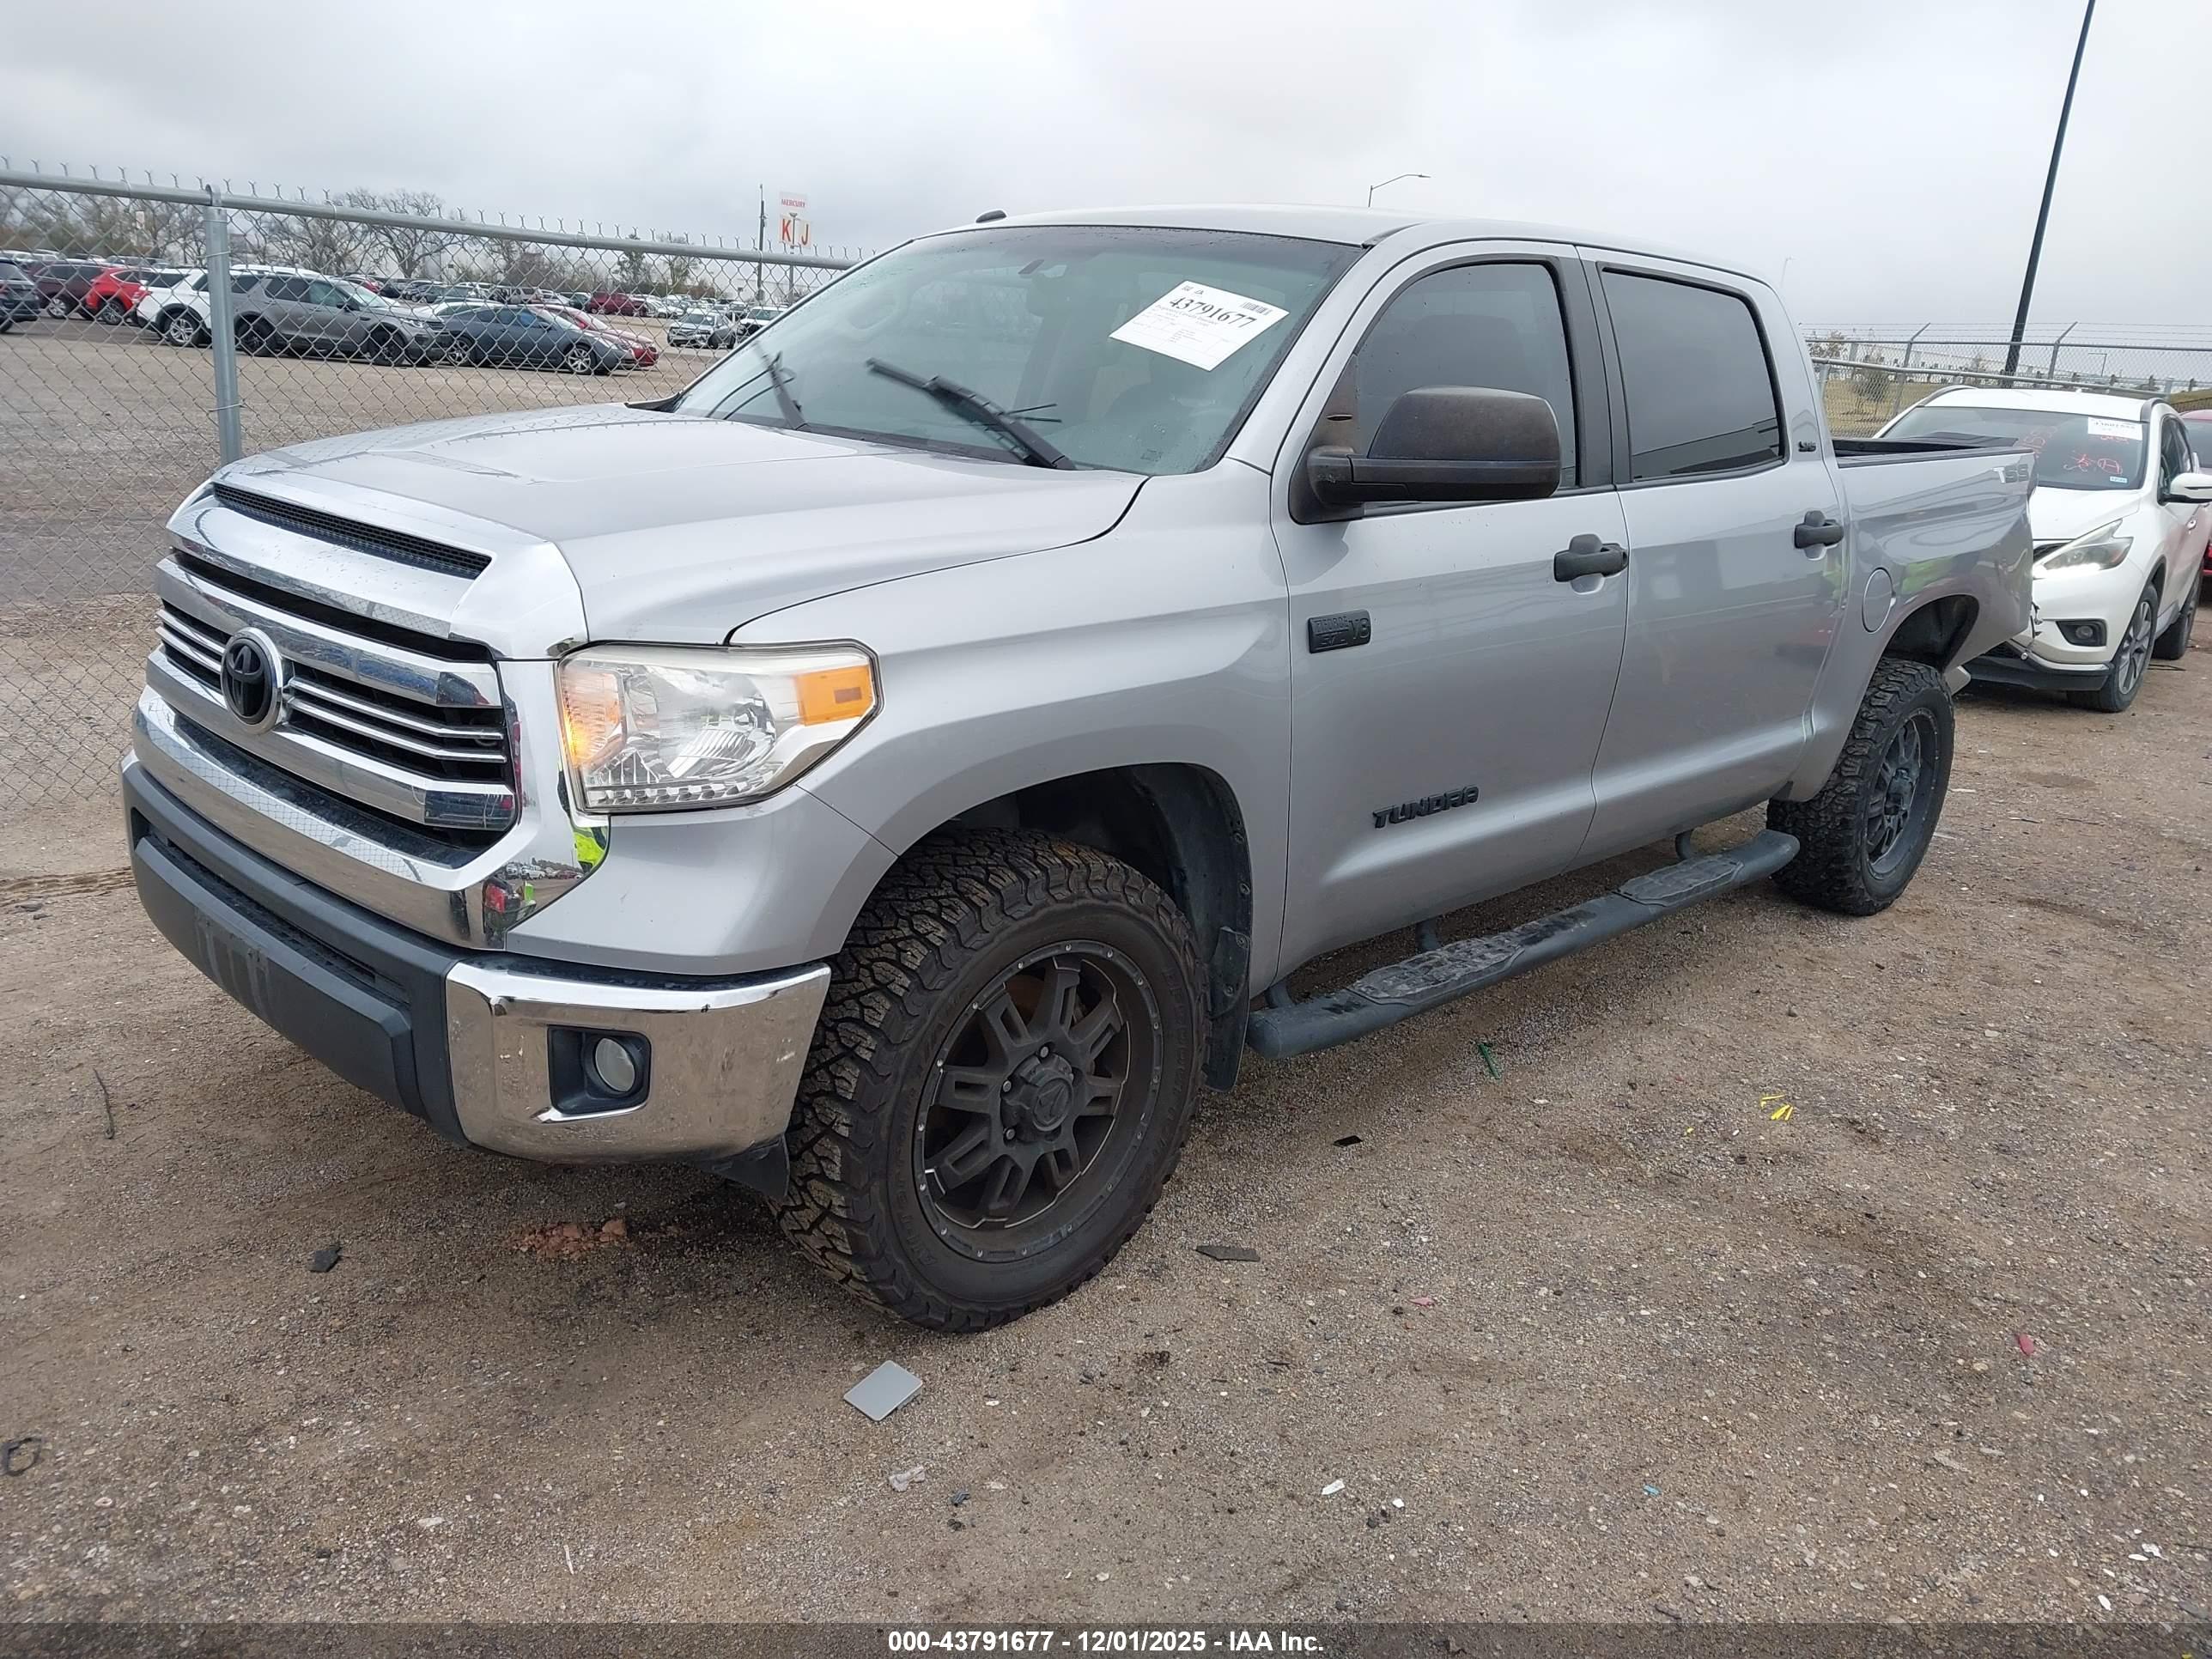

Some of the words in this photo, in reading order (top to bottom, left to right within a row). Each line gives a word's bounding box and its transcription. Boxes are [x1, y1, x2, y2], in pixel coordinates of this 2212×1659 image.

[781, 198, 805, 208] MERCURY
[1170, 296, 1258, 328] 43791677
[1372, 786, 1479, 829] TUNDRA
